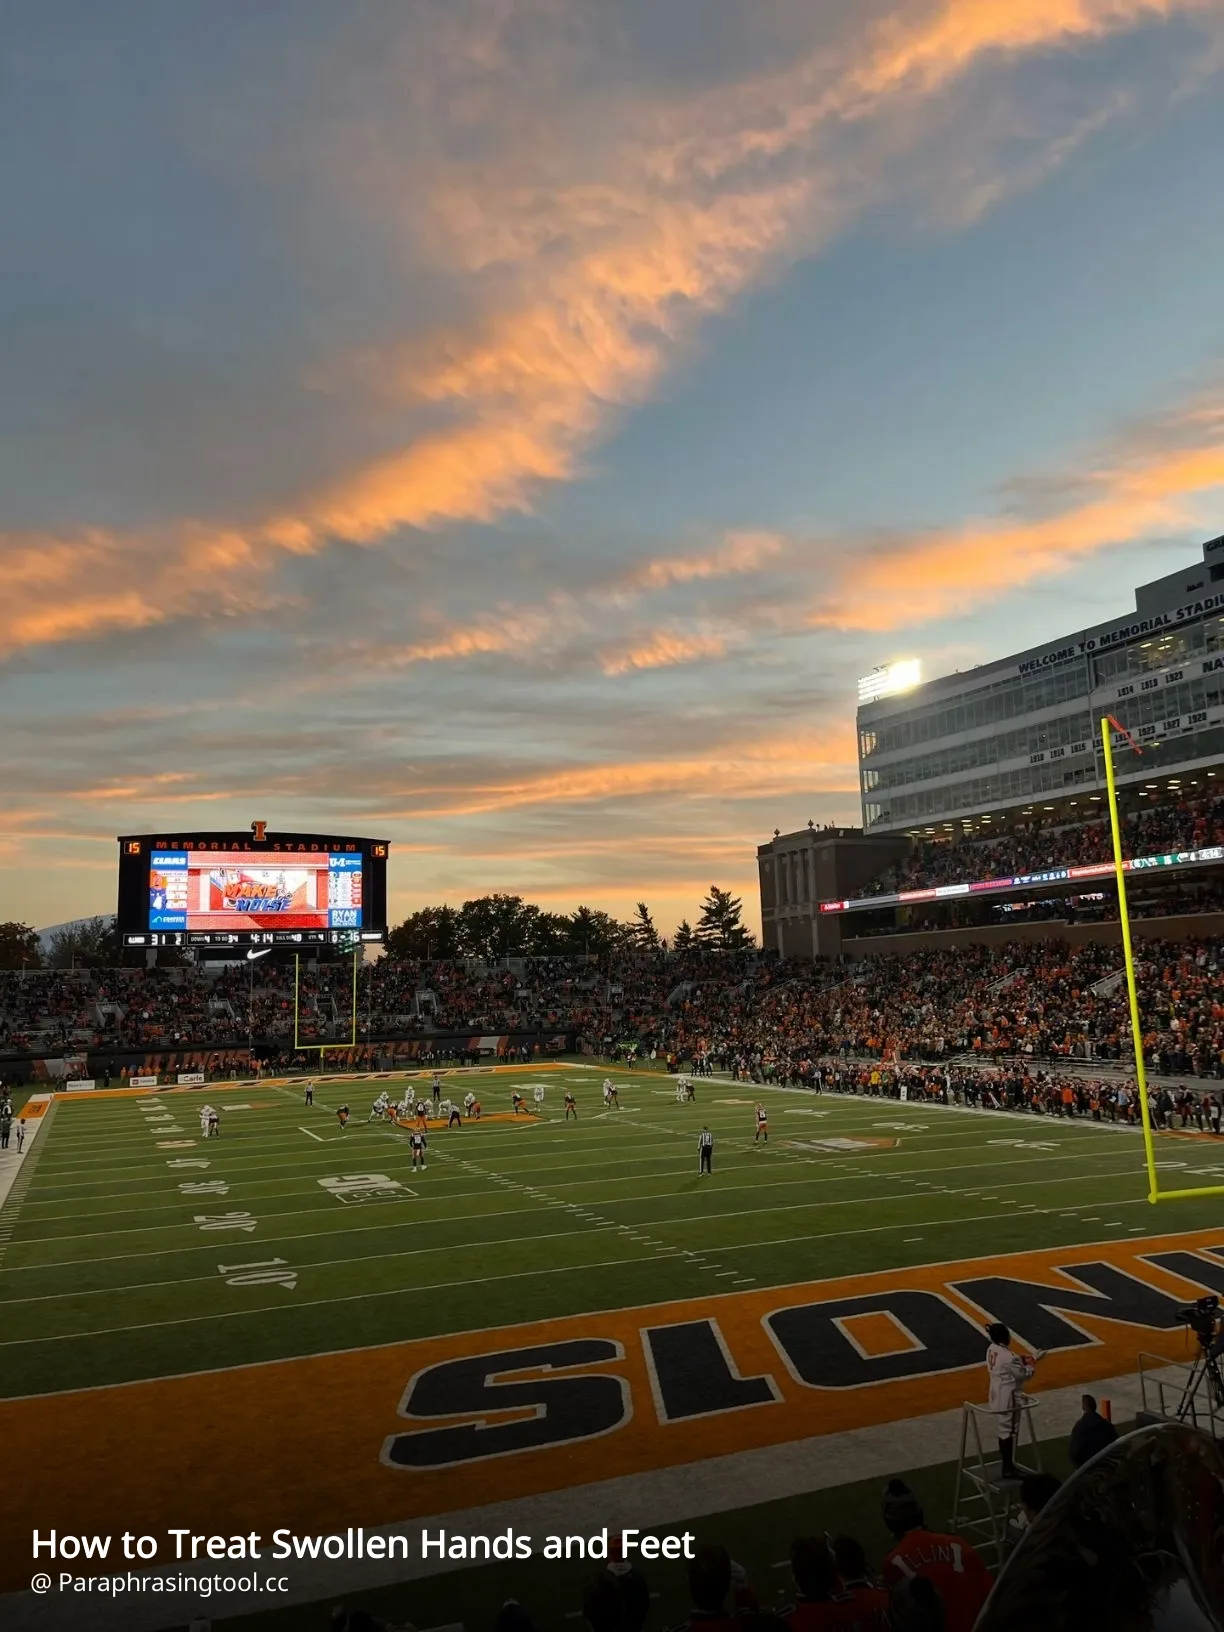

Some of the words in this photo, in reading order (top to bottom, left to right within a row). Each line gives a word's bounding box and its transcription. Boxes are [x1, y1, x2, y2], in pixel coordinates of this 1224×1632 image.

[1018, 646, 1075, 673] WELCOME
[1078, 640, 1096, 652] TO
[1100, 613, 1172, 646] MEMORIAL
[128, 842, 140, 853] 15
[155, 841, 252, 850] MEMORIAL
[273, 843, 357, 852] STADIUM
[375, 846, 386, 856] 15
[222, 883, 278, 898] MAKE
[236, 896, 291, 912] NOISE
[250, 933, 274, 944] 4:14
[193, 1211, 258, 1231] 20
[217, 1257, 298, 1287] 10
[891, 1542, 964, 1581] ILLINI
